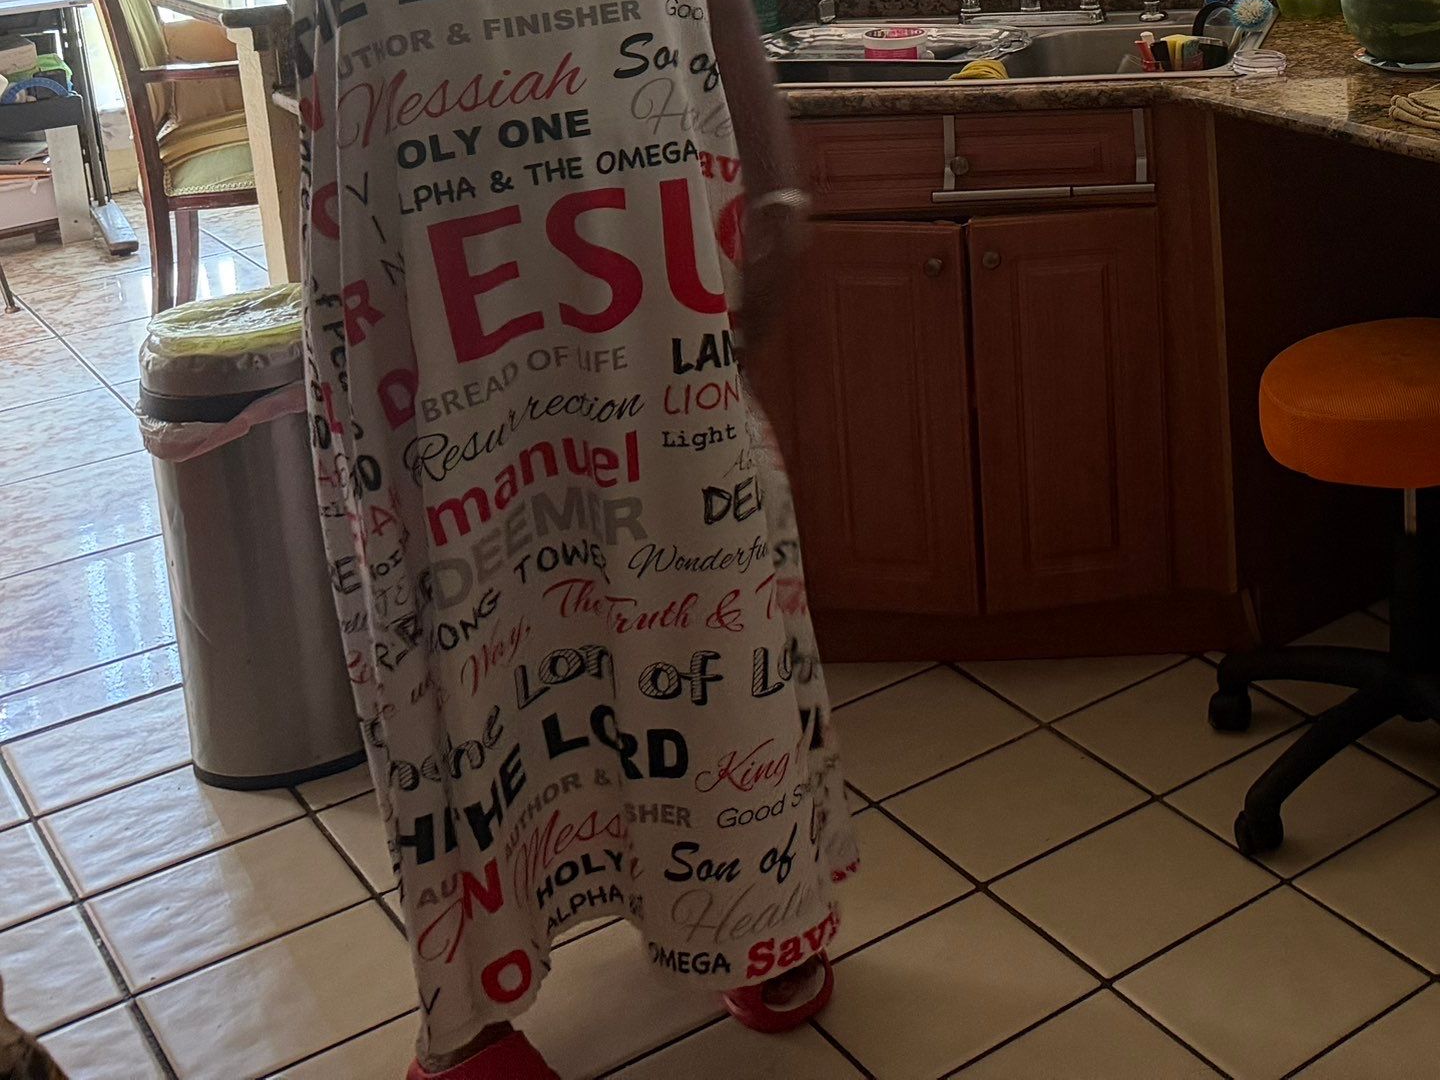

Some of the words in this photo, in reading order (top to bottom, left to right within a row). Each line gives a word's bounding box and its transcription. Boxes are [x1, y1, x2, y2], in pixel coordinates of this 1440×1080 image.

[447, 22, 472, 46] &
[484, 0, 643, 41] FINISHER
[397, 125, 483, 170] OLY
[498, 108, 592, 149] ONE
[490, 170, 516, 194] &
[523, 157, 584, 186] THE
[596, 139, 700, 176] OMEGA
[420, 361, 519, 422] BREAD
[526, 345, 569, 371] OF
[663, 381, 739, 415] LION
[661, 423, 737, 451] Light
[706, 589, 744, 631] &
[639, 650, 724, 706] of
[717, 794, 786, 828] Good
[664, 841, 745, 883] Son
[759, 822, 798, 884] of
